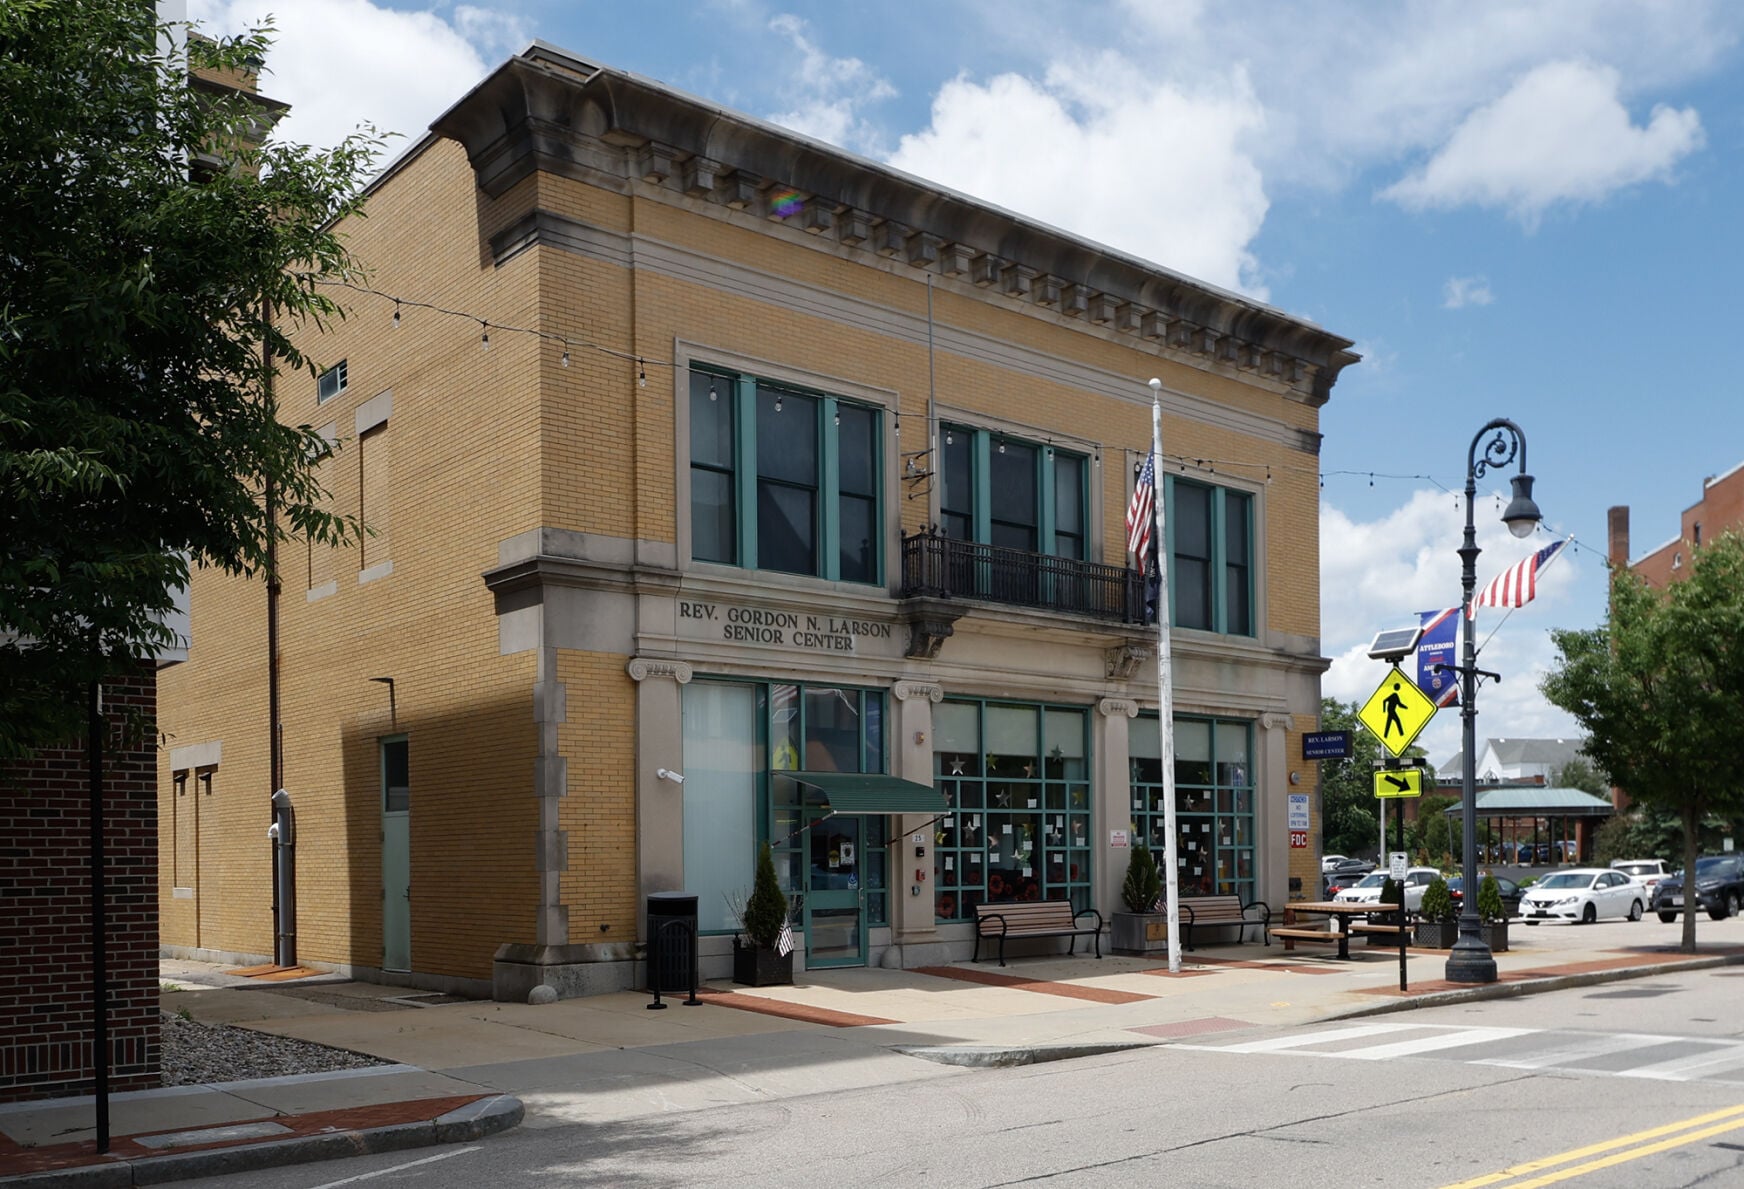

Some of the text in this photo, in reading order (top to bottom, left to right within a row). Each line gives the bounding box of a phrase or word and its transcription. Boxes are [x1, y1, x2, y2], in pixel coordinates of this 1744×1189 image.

[679, 602, 891, 638] REV. GORDON N. LARSON
[723, 624, 853, 650] SENIOR CENTER
[1420, 641, 1454, 651] ATTLEBORO
[1291, 834, 1306, 846] FDC
